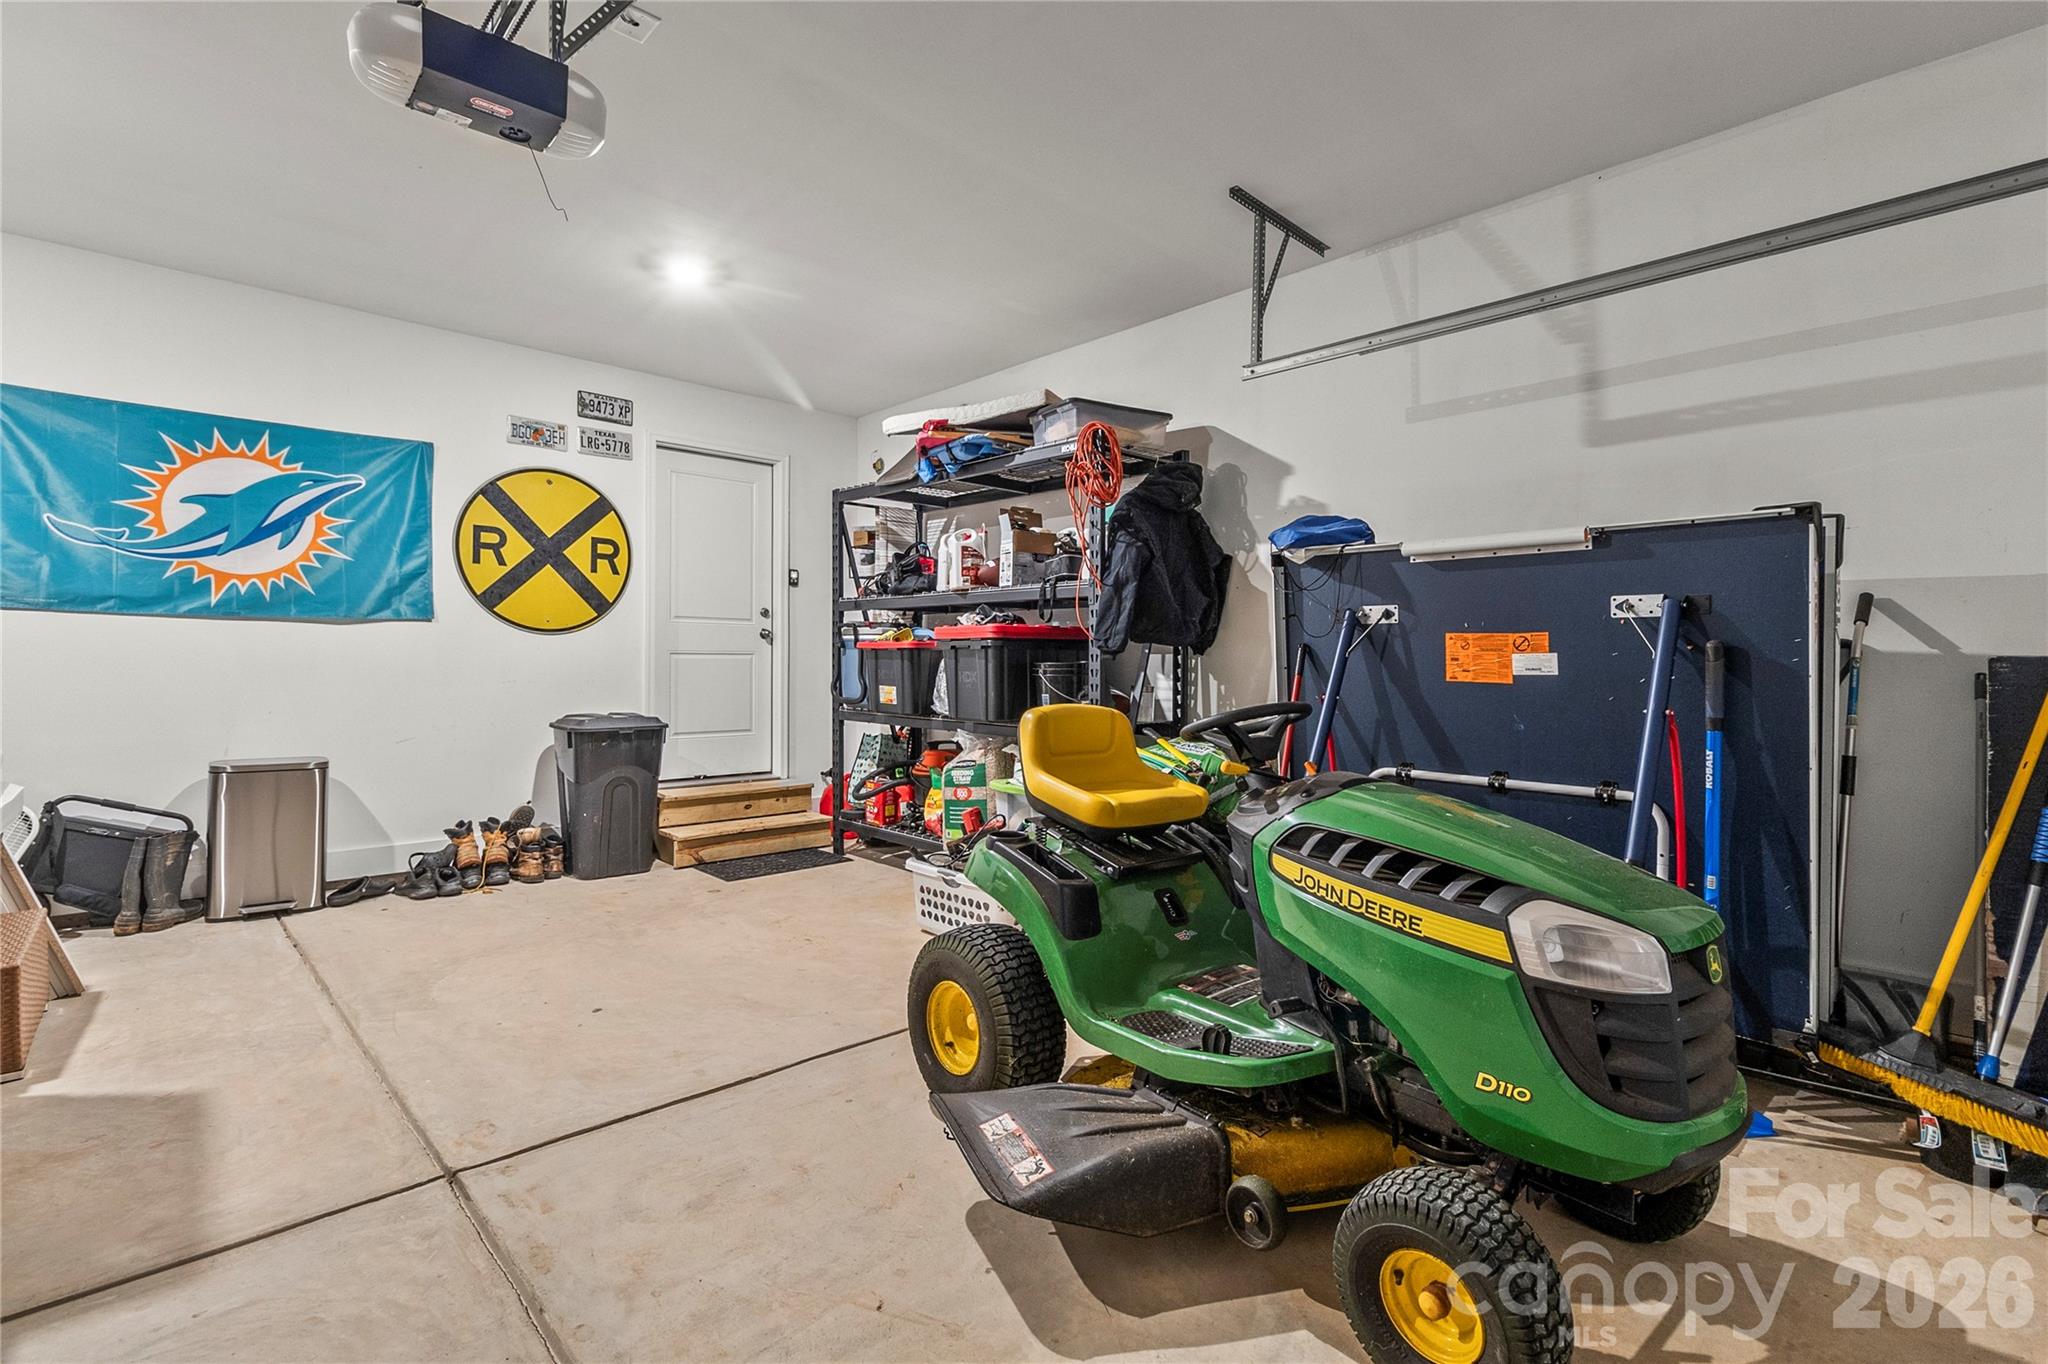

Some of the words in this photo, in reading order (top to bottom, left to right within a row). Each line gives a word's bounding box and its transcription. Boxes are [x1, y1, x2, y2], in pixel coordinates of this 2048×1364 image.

[589, 400, 615, 416] 9473
[618, 404, 631, 419] XP
[545, 428, 566, 445] 3EH
[594, 430, 616, 438] TEXAS
[472, 524, 508, 567] R
[590, 537, 620, 576] R
[1705, 749, 1713, 789] KOBALT
[1294, 867, 1344, 903] JOHN
[1347, 890, 1423, 934] DEERE
[1474, 1071, 1532, 1103] D110
